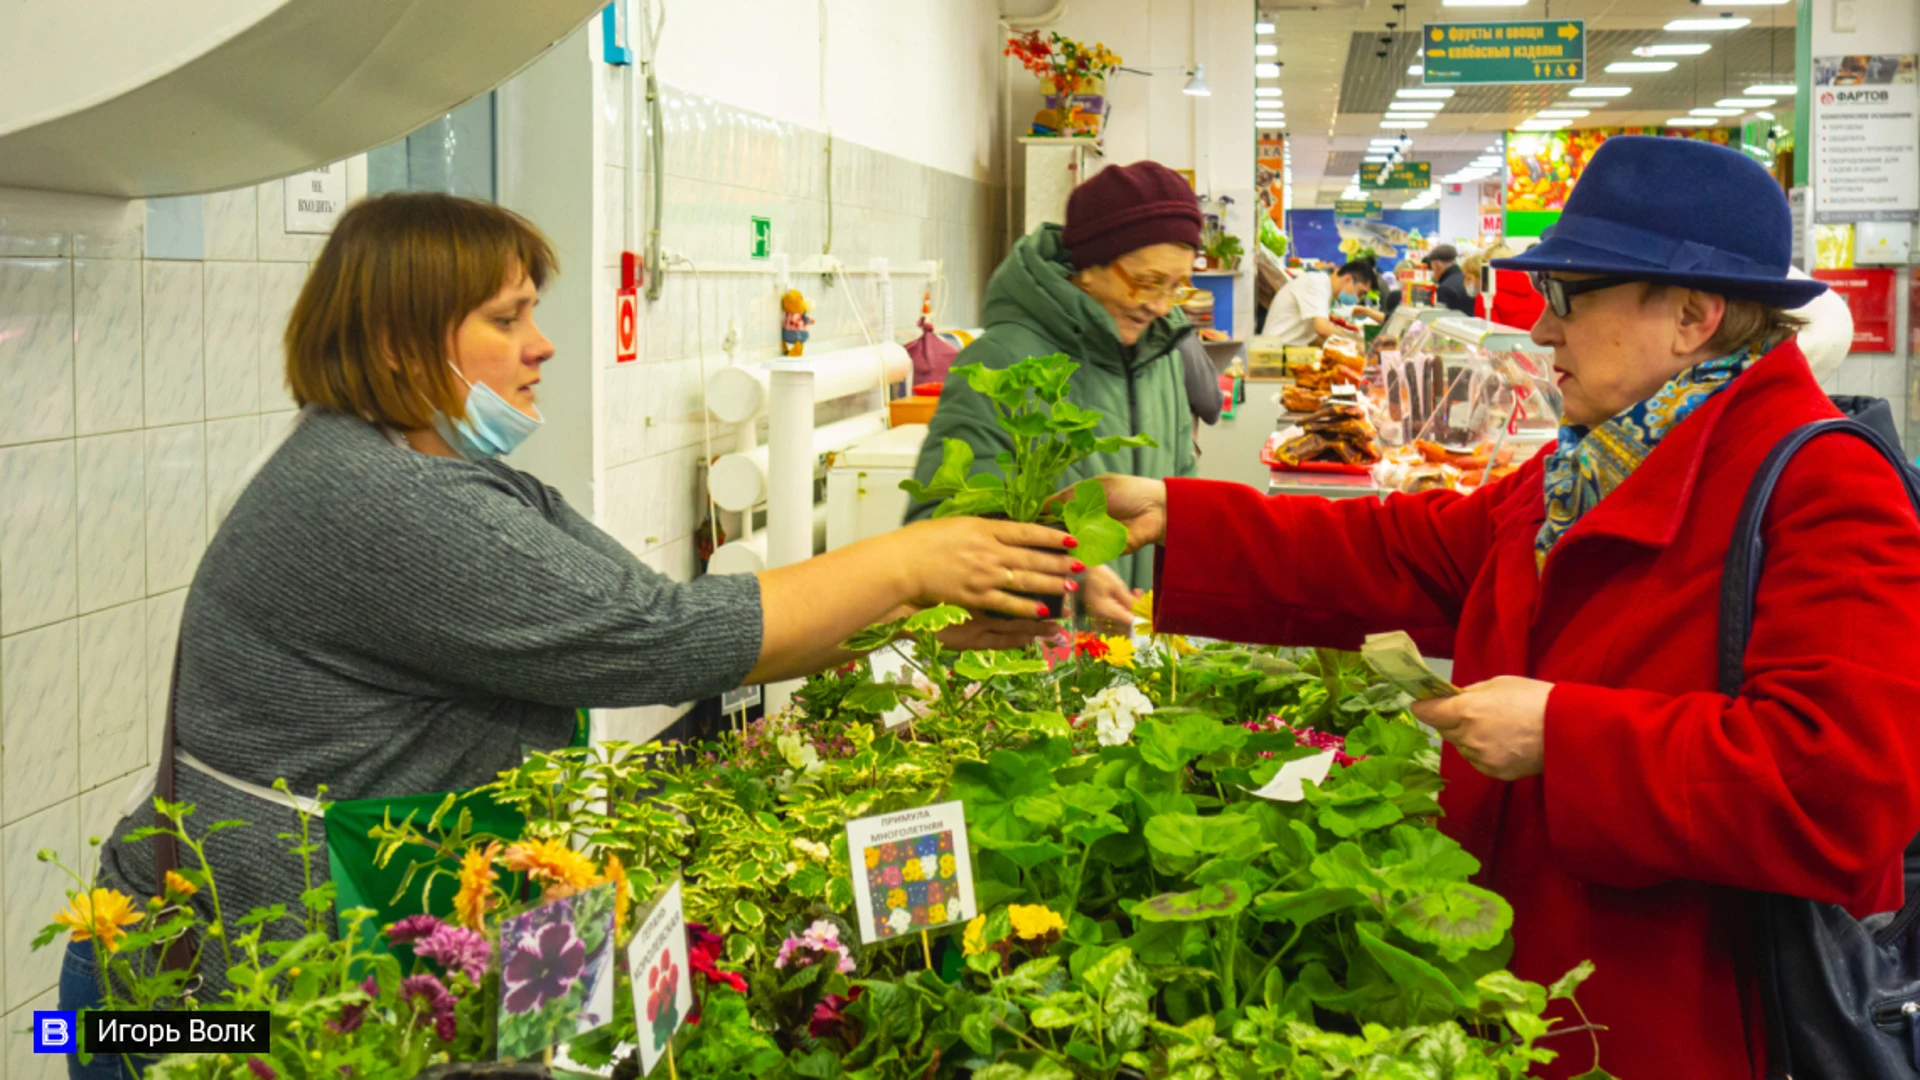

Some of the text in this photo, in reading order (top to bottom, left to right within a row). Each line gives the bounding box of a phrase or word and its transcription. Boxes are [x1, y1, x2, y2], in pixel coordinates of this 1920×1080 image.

[1495, 27, 1503, 39] и
[1506, 26, 1544, 40] овощи
[1448, 44, 1563, 59] колбасные изделия
[1836, 90, 1889, 101] ФАРТОВ
[881, 810, 931, 827] ПРИМУЛА
[870, 820, 944, 842] МНОГОЛЕТНЯЯ
